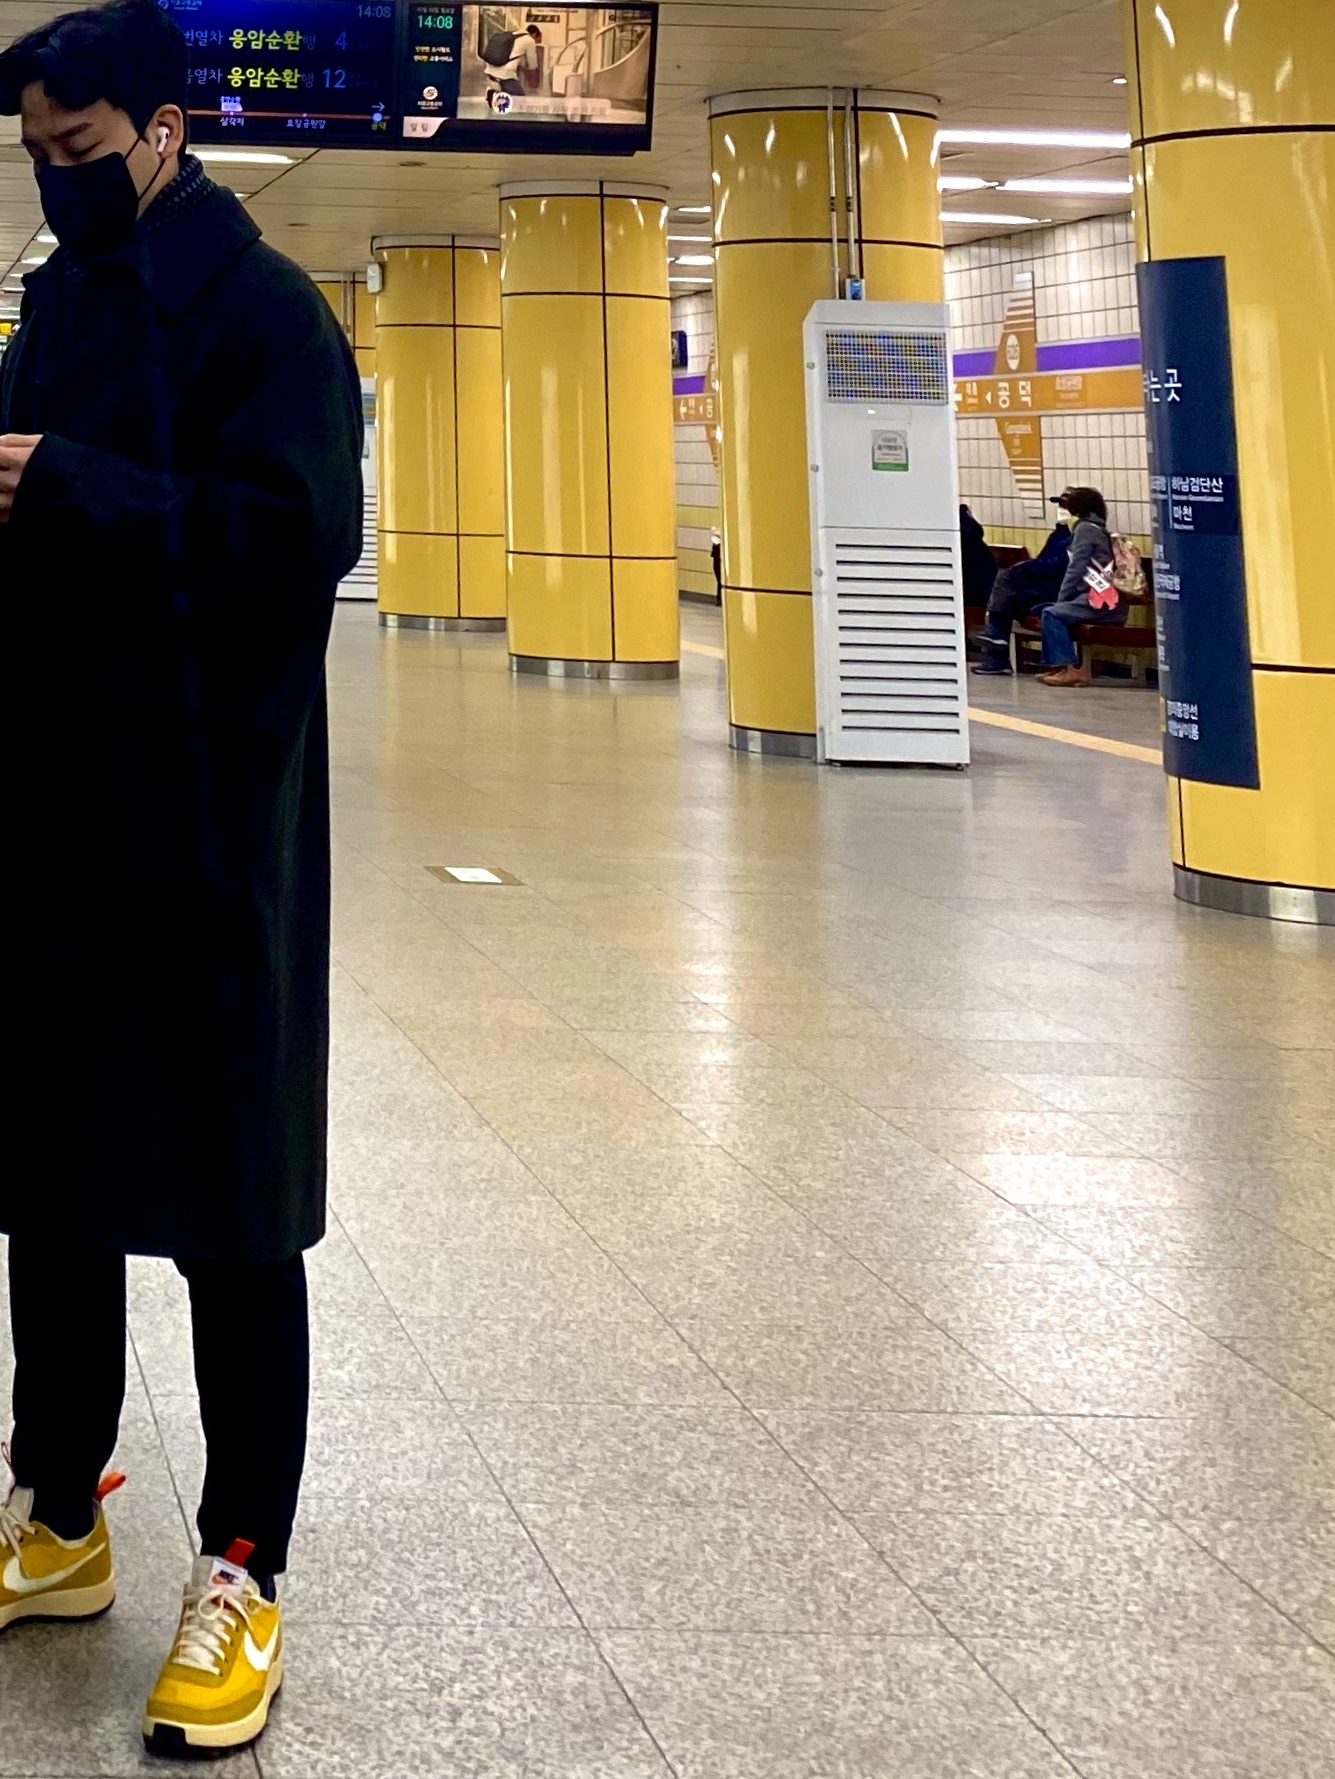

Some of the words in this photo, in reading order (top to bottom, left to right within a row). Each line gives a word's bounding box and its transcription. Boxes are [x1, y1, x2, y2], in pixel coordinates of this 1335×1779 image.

[357, 5, 391, 18] 14:08
[417, 15, 453, 29] 14:08
[335, 31, 348, 51] 4
[322, 69, 346, 89] 12
[998, 380, 1032, 409] 공덕
[1164, 369, 1182, 402] 곳
[1171, 476, 1223, 493] 하남검단산
[1173, 505, 1193, 521] 마천
